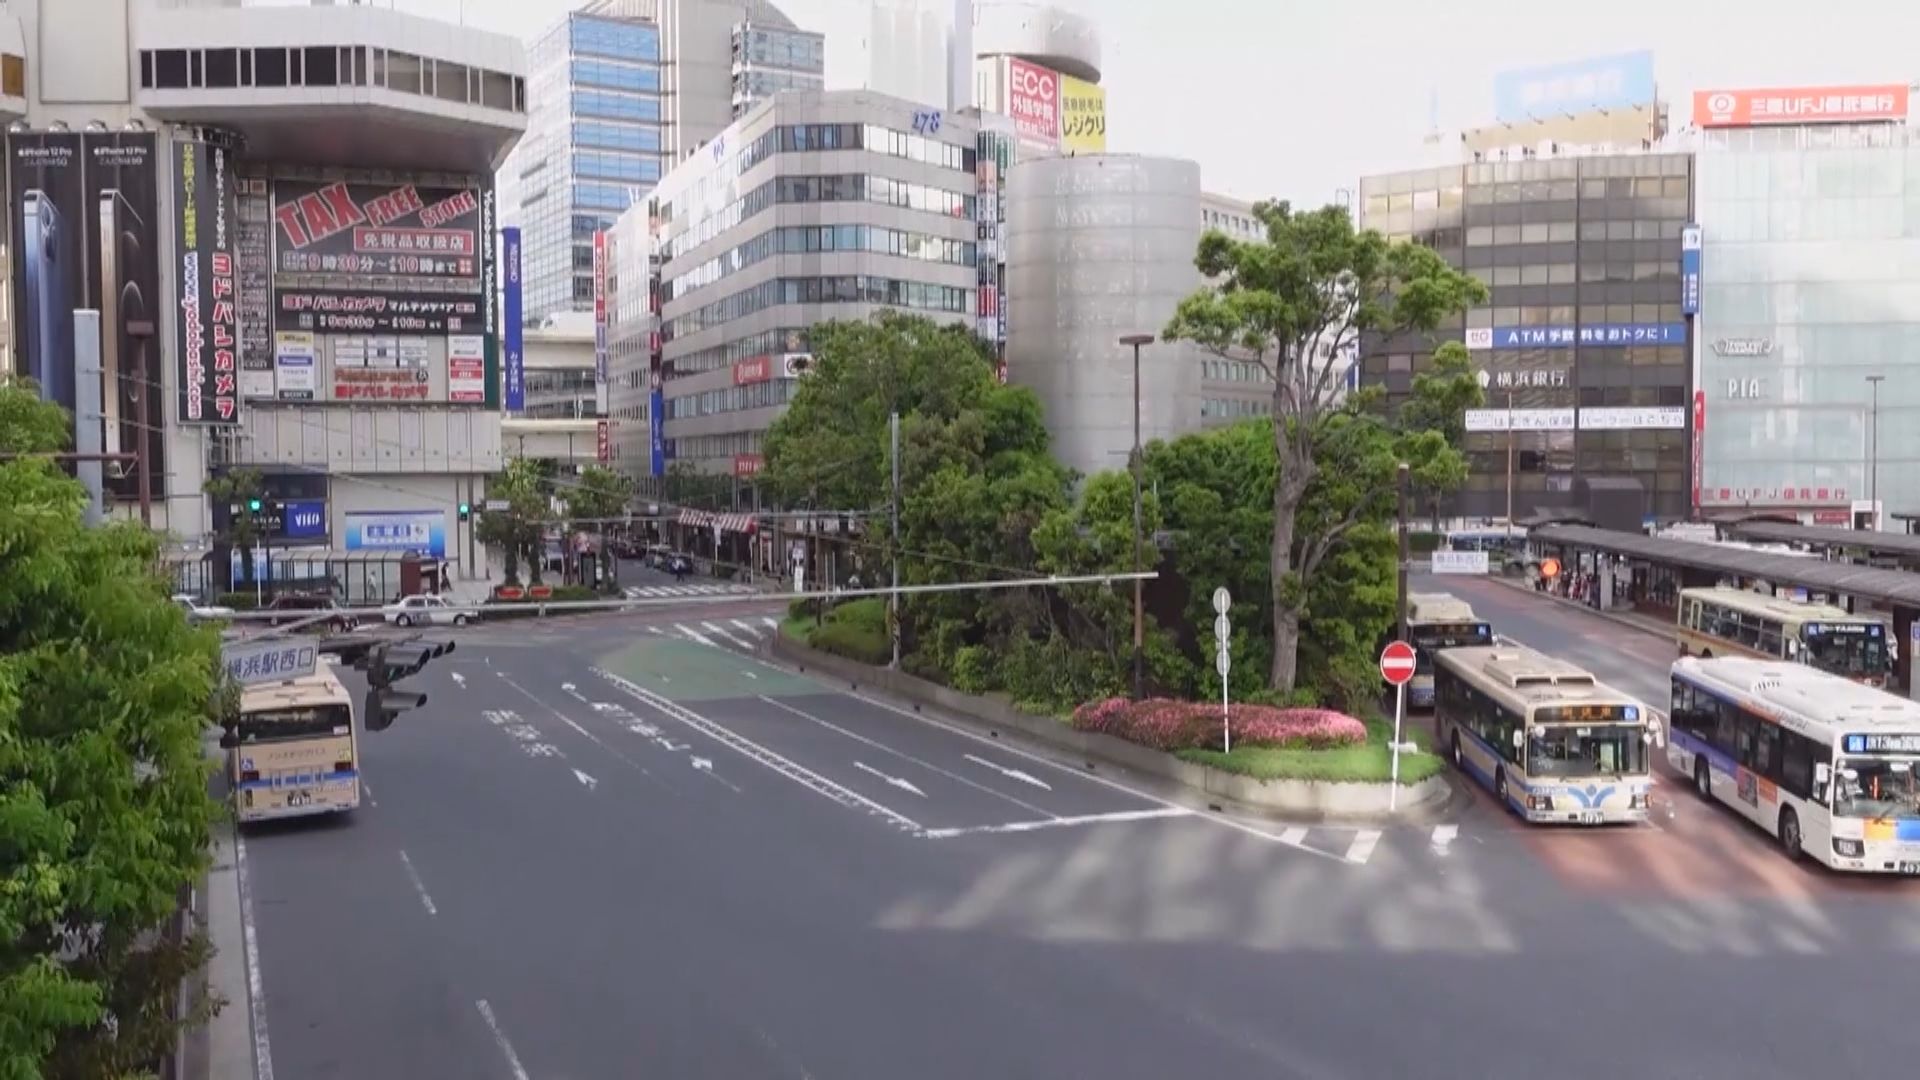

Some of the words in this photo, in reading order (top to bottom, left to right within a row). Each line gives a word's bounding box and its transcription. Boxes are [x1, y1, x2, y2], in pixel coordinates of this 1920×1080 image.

[1012, 65, 1054, 101] ECC
[276, 181, 366, 249] TAX
[363, 183, 424, 228] FREE
[418, 190, 477, 228] STORE
[181, 252, 204, 418] www.yodobashi.com
[212, 252, 234, 419] ヨドバシカメラ
[1497, 370, 1566, 388] 横浜銀行
[1728, 378, 1759, 398] PIA
